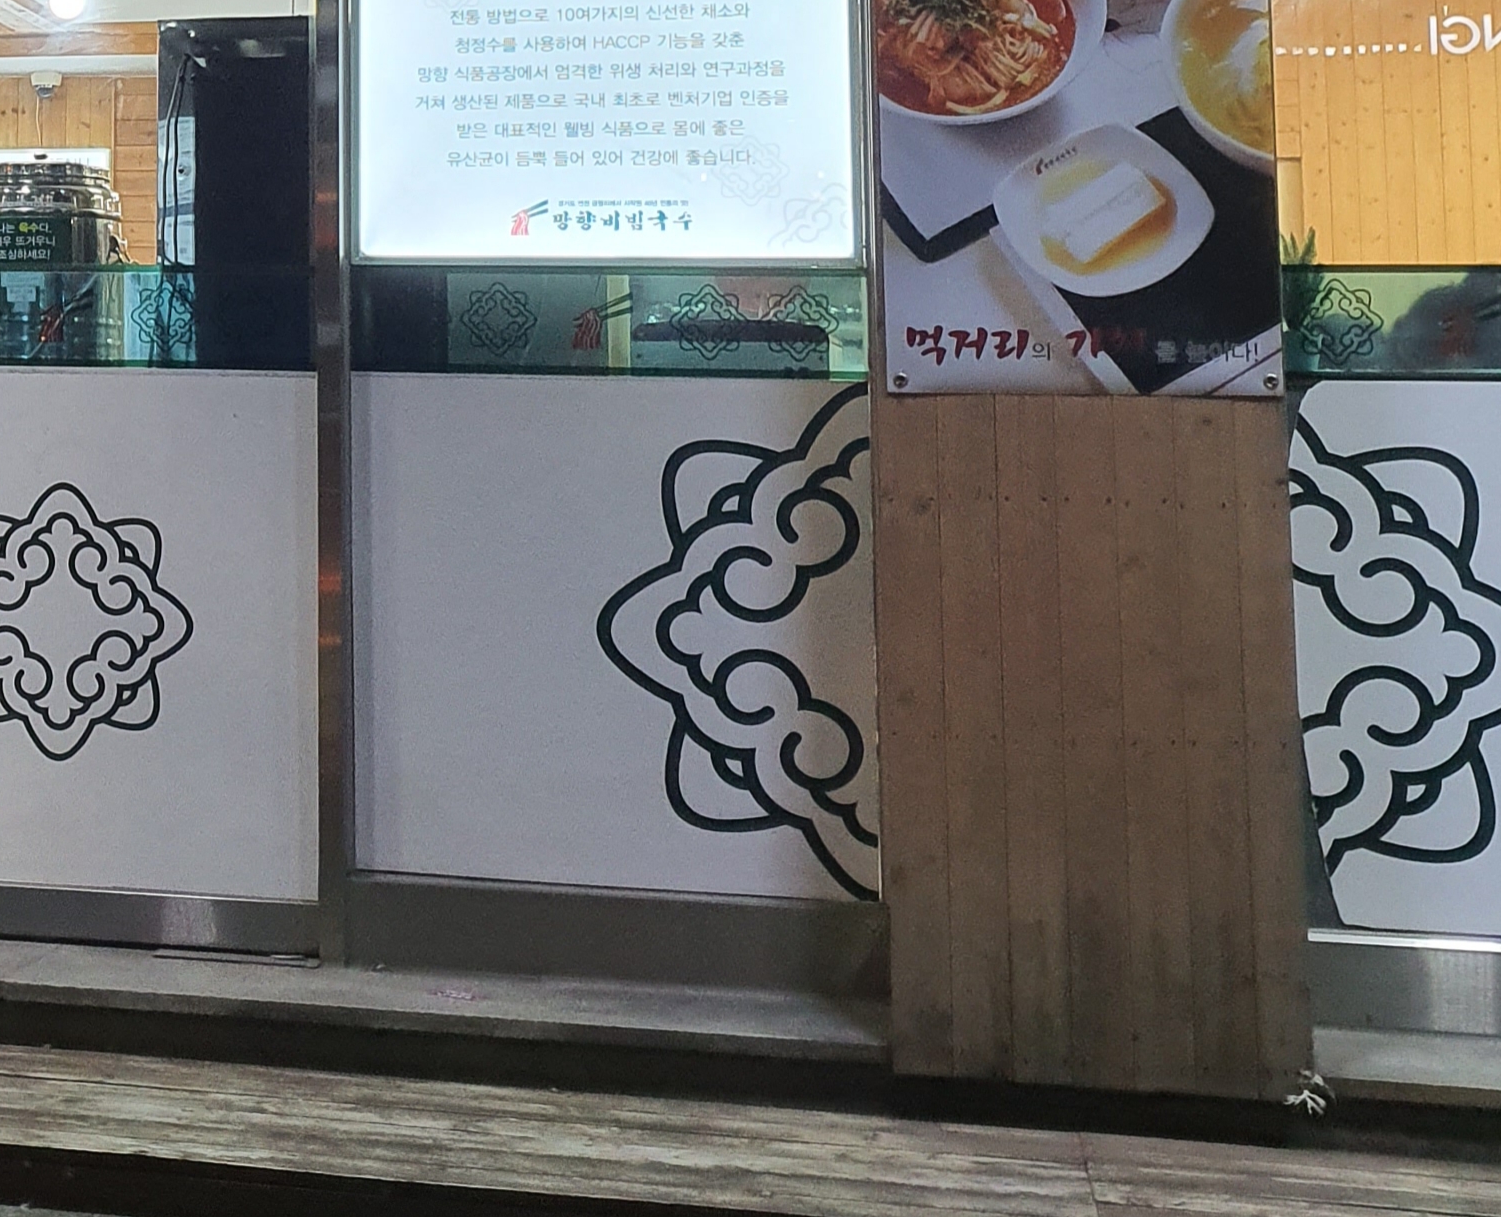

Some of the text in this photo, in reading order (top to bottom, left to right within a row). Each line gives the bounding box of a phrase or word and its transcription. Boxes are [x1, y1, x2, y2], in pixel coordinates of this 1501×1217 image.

[449, 2, 750, 26] 전통 방법으로 10여가지의 신선한 채소와
[455, 30, 745, 55] 청정수를 사용하여 HACCP 기능을 갖춘
[417, 59, 787, 83] 망향 식품공장에서 엄격한 위생 처리와 연구과정을
[414, 88, 790, 111] 거쳐 생산된 제품으로 국내 최초로 벤처기업 인증을
[456, 117, 745, 139] 받은 대표적인 웰빙 식품으로 몸에 좋은
[446, 147, 757, 168] 유산균이 듬뿍 들어 있어 건강에 좋습니다.
[552, 209, 694, 231] 망향비빔국수
[15, 235, 56, 246] 뜨거우니
[906, 325, 1052, 367] 먹거리의
